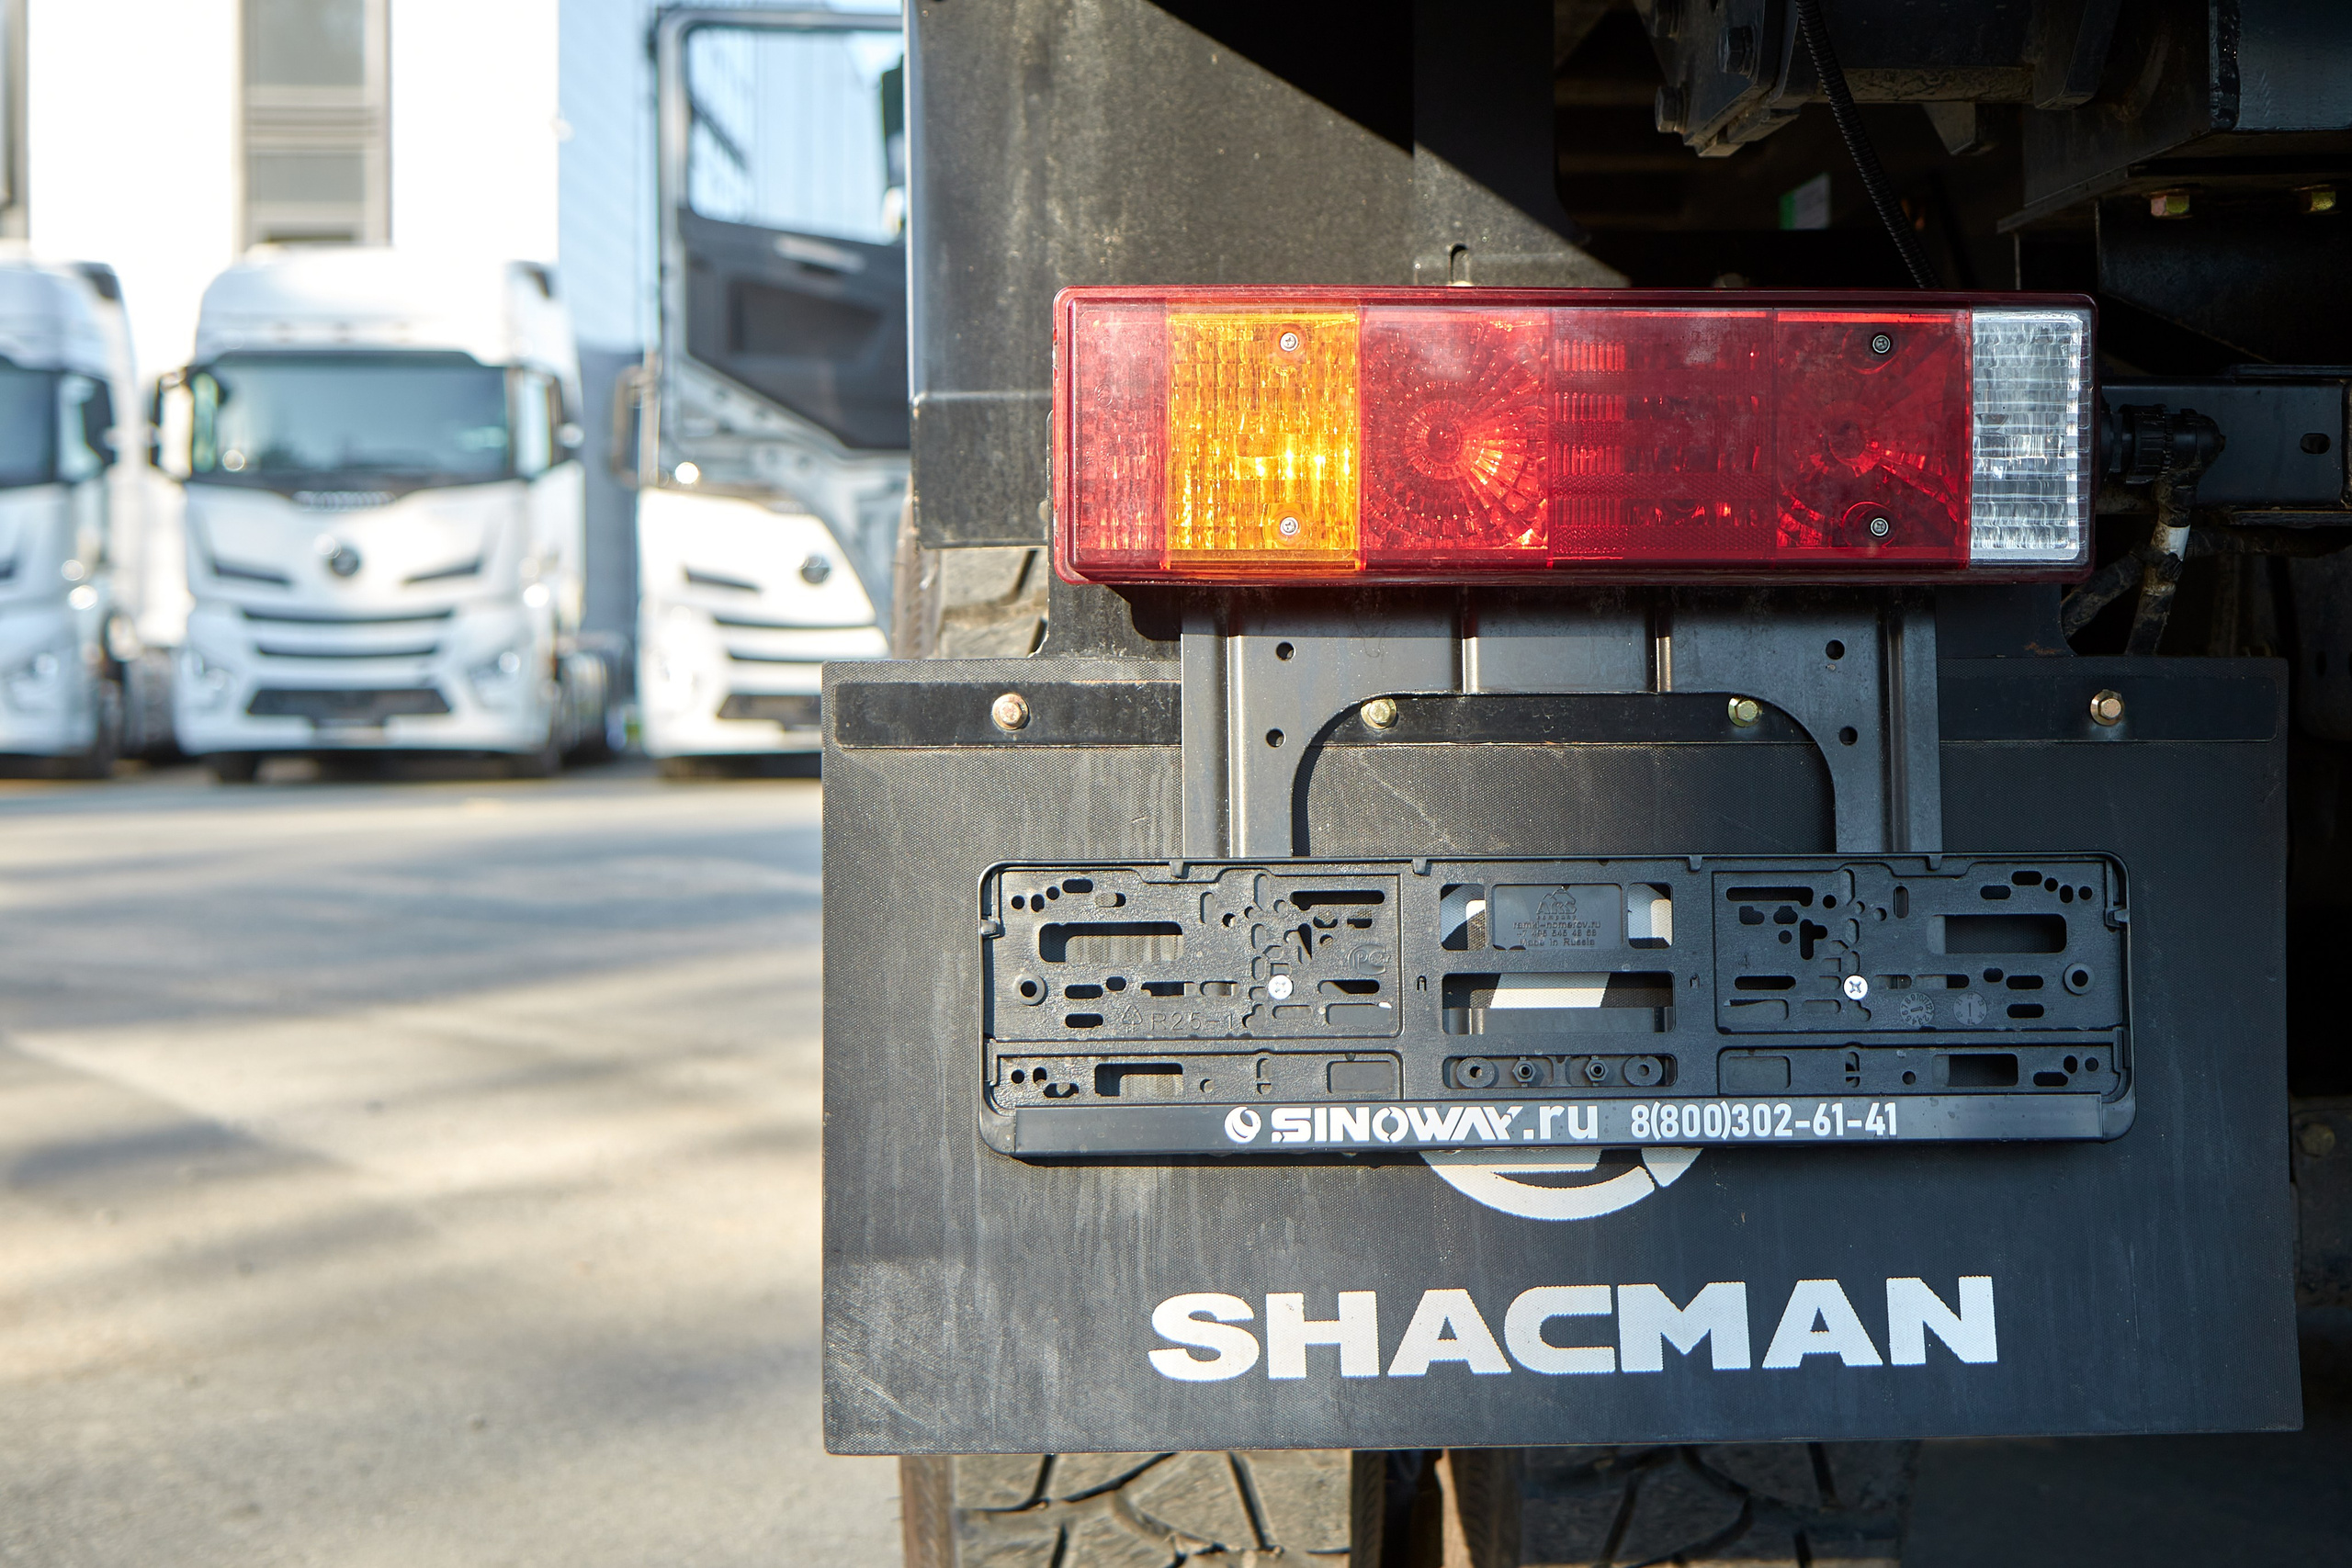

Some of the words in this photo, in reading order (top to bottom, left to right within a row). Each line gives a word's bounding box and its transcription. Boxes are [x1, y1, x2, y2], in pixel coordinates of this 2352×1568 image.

[1520, 937, 1545, 947] Made
[1550, 937, 1558, 946] in
[1563, 937, 1595, 947] Russia
[1150, 1011, 1233, 1031] R25-1
[1271, 1105, 1599, 1145] SINOWAY.ru
[1631, 1100, 1898, 1142] 8(800)302-61-41
[1148, 1275, 1999, 1382] SHACMAN
